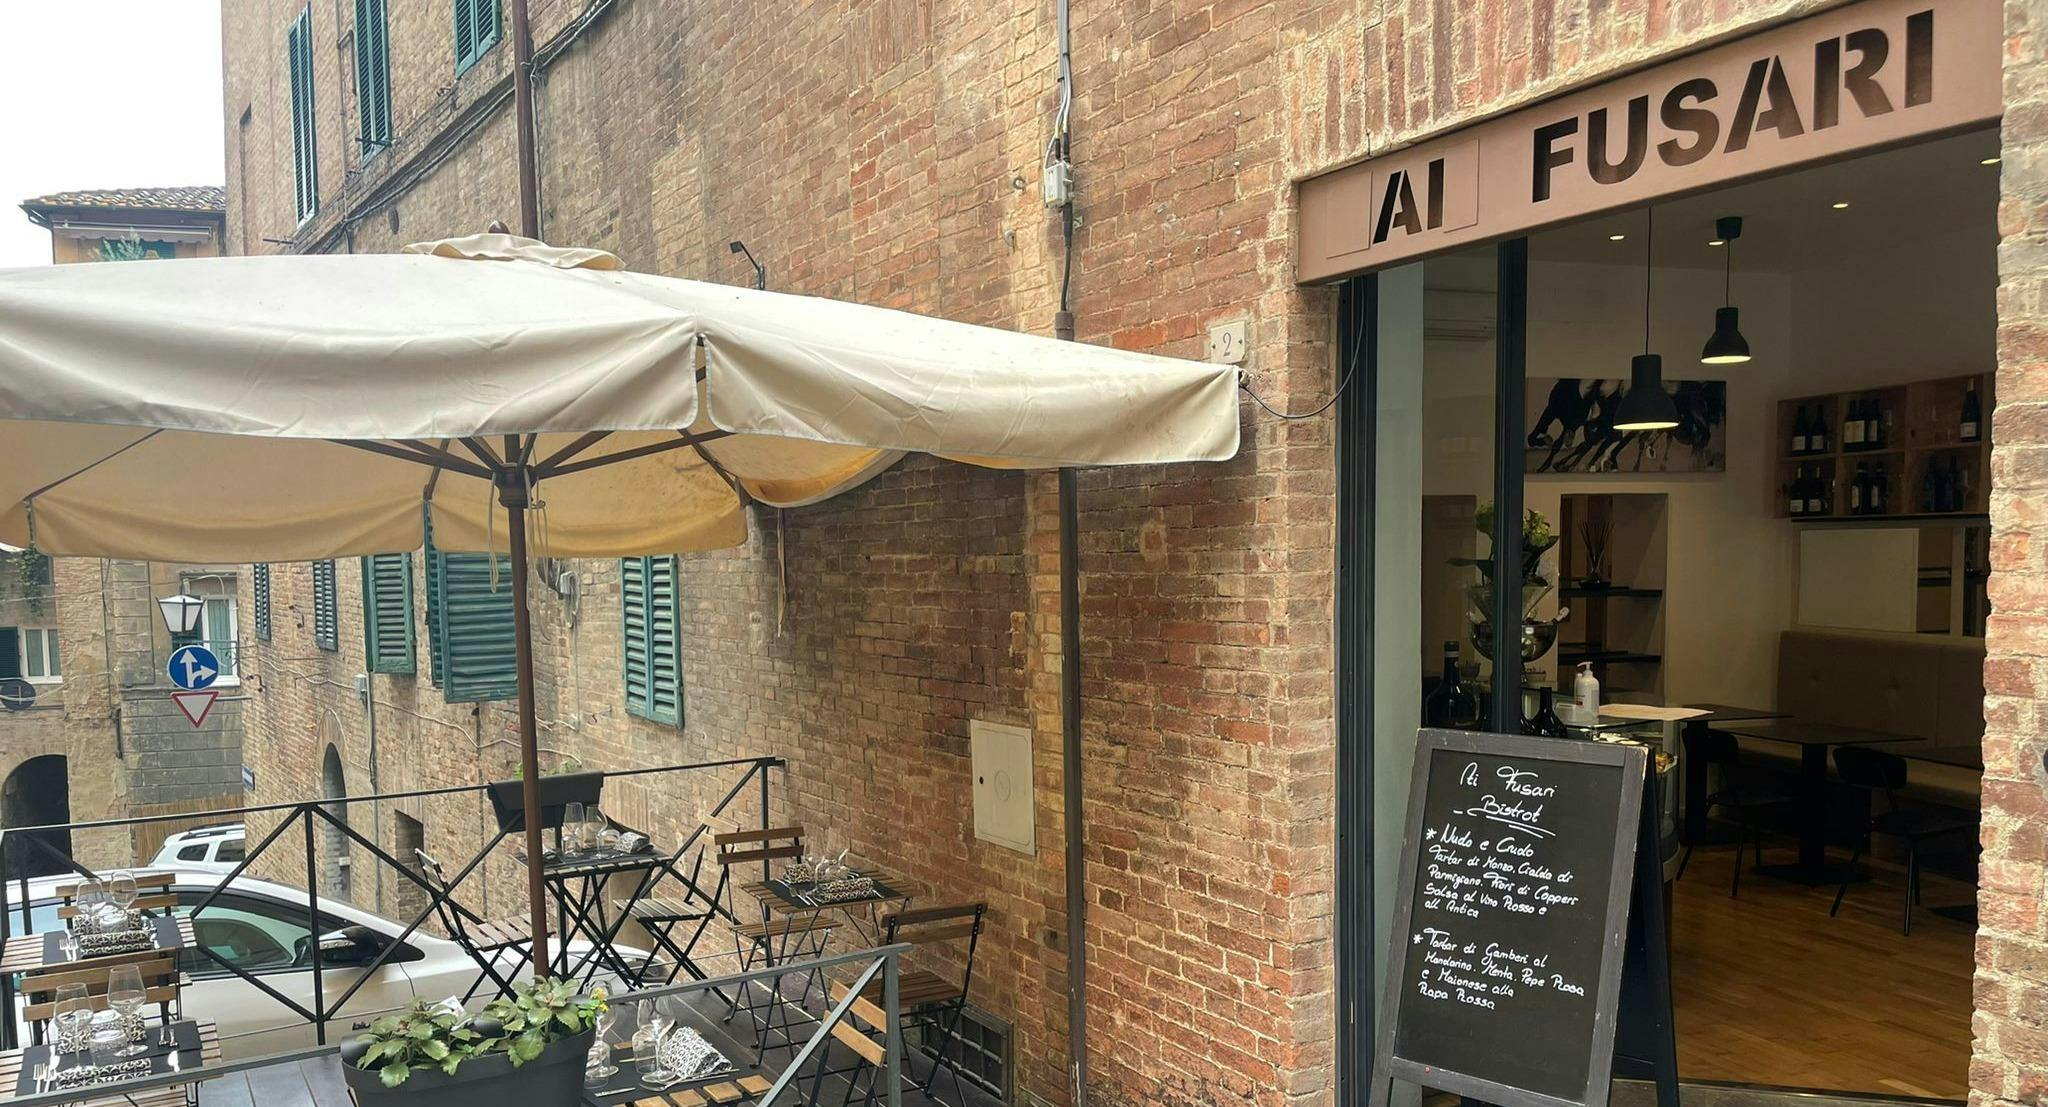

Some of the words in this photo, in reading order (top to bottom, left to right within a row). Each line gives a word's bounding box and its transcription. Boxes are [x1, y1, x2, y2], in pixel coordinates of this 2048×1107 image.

[1373, 158, 1444, 244] AI
[1532, 9, 1933, 203] FUSARI
[1223, 332, 1232, 356] 2
[1496, 766, 1558, 797] Fusari
[1467, 794, 1543, 822] Bistrot
[1440, 823, 1473, 848] Nudo
[1479, 840, 1490, 851] e
[1496, 837, 1534, 857] Crudo
[1428, 844, 1463, 866] Tartar
[1467, 856, 1480, 867] di
[1557, 870, 1573, 883] di
[1424, 882, 1458, 900] Salsa
[1463, 890, 1478, 902] al
[1480, 893, 1498, 908] Vino
[1502, 895, 1535, 914] Rosso
[1517, 884, 1531, 896] di
[1463, 942, 1477, 954] di
[1481, 943, 1528, 965] Gamberi
[1533, 954, 1548, 968] al
[1417, 981, 1449, 1000] Rapa
[1455, 987, 1496, 1010] Rossa
[1437, 967, 1488, 992] Maionese
[1491, 984, 1514, 998] alla
[1521, 968, 1545, 987] Pepe
[1550, 974, 1585, 997] Rosa
